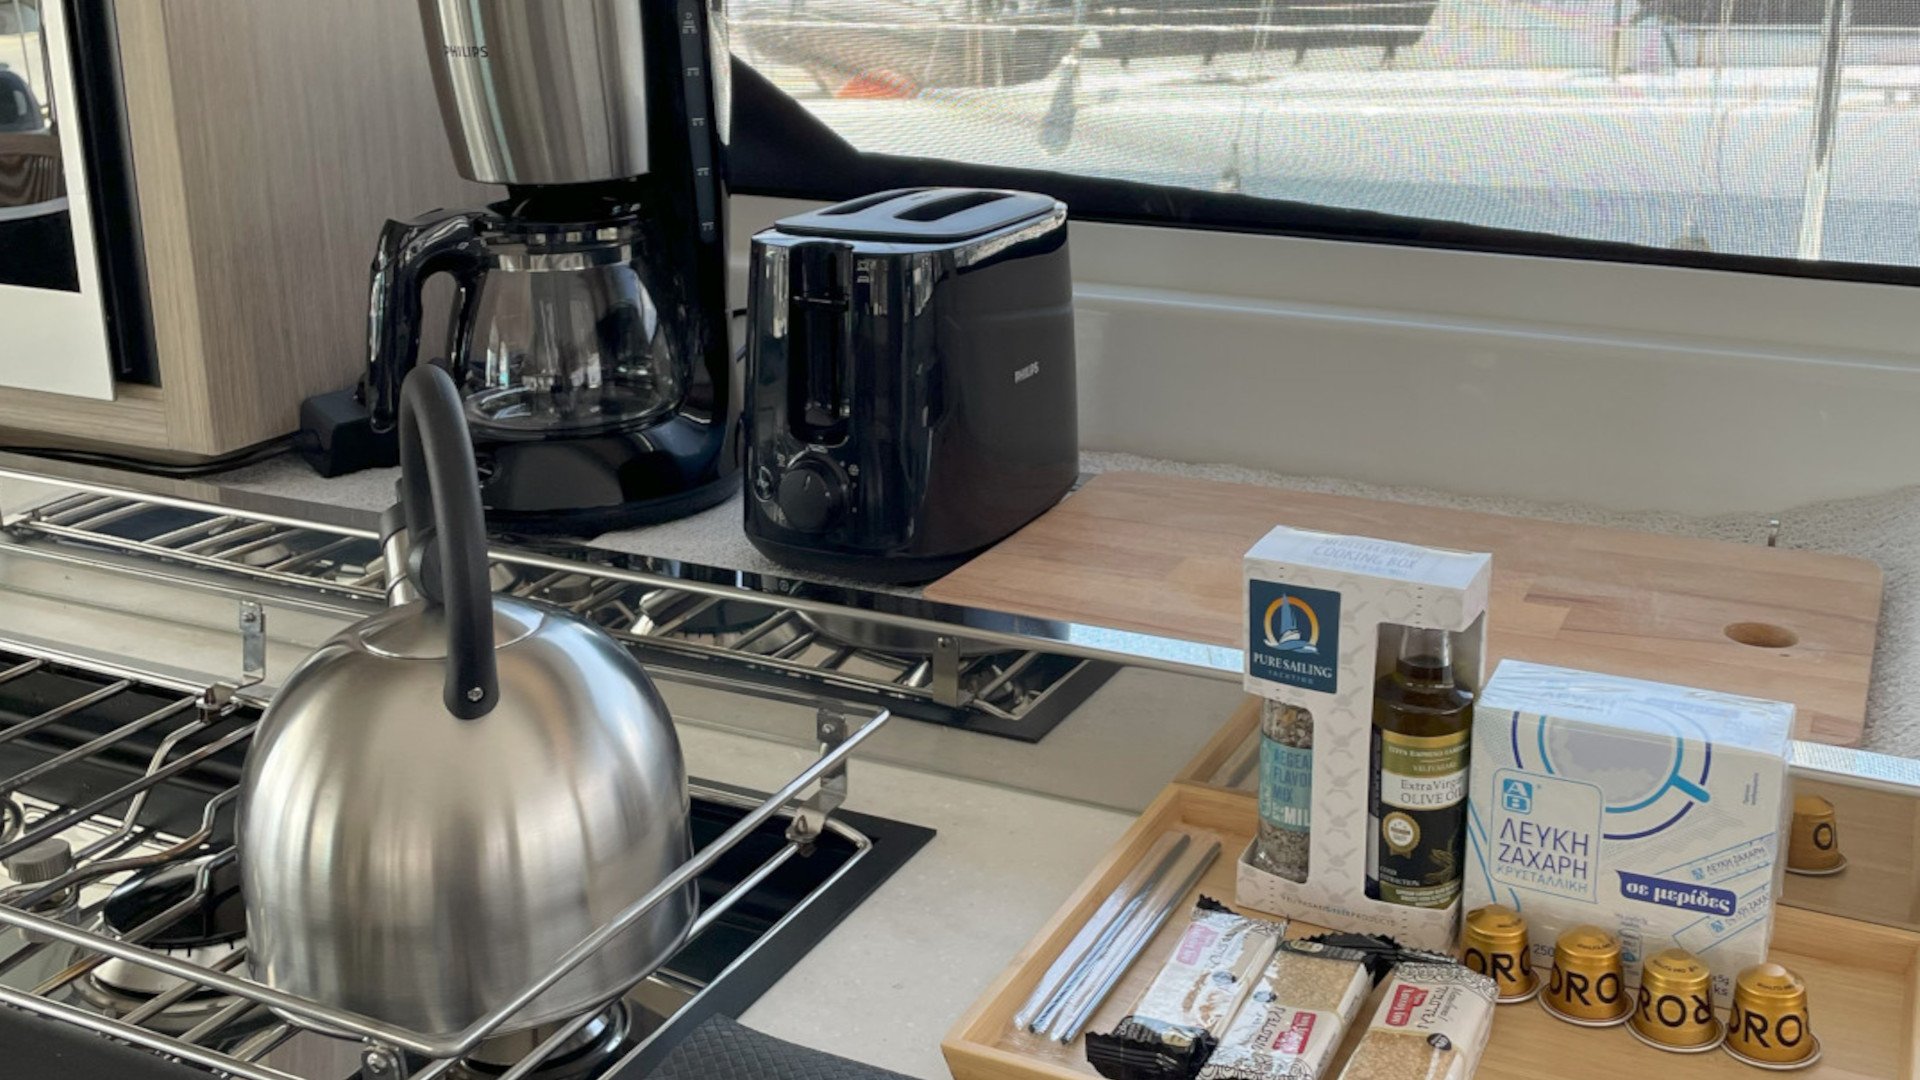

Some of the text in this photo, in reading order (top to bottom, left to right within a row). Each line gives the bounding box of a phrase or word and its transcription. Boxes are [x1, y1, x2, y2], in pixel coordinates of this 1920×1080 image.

[443, 45, 489, 58] PHILIPS
[1313, 545, 1382, 565] COOKING
[1387, 556, 1419, 569] BOX
[1274, 749, 1312, 769] AEGEA
[1272, 784, 1293, 803] MIX
[1400, 780, 1432, 791] Extra
[1401, 792, 1441, 805] OLIVE
[1500, 818, 1589, 857] ΛΕΥΚΗ
[1498, 842, 1588, 880] ΖΑΧΑΡΗ
[1496, 866, 1588, 893] ΚΡΥΣΤΑΛΛΙΚΗ
[1626, 882, 1649, 896] σε
[1654, 888, 1731, 913] μερίδες
